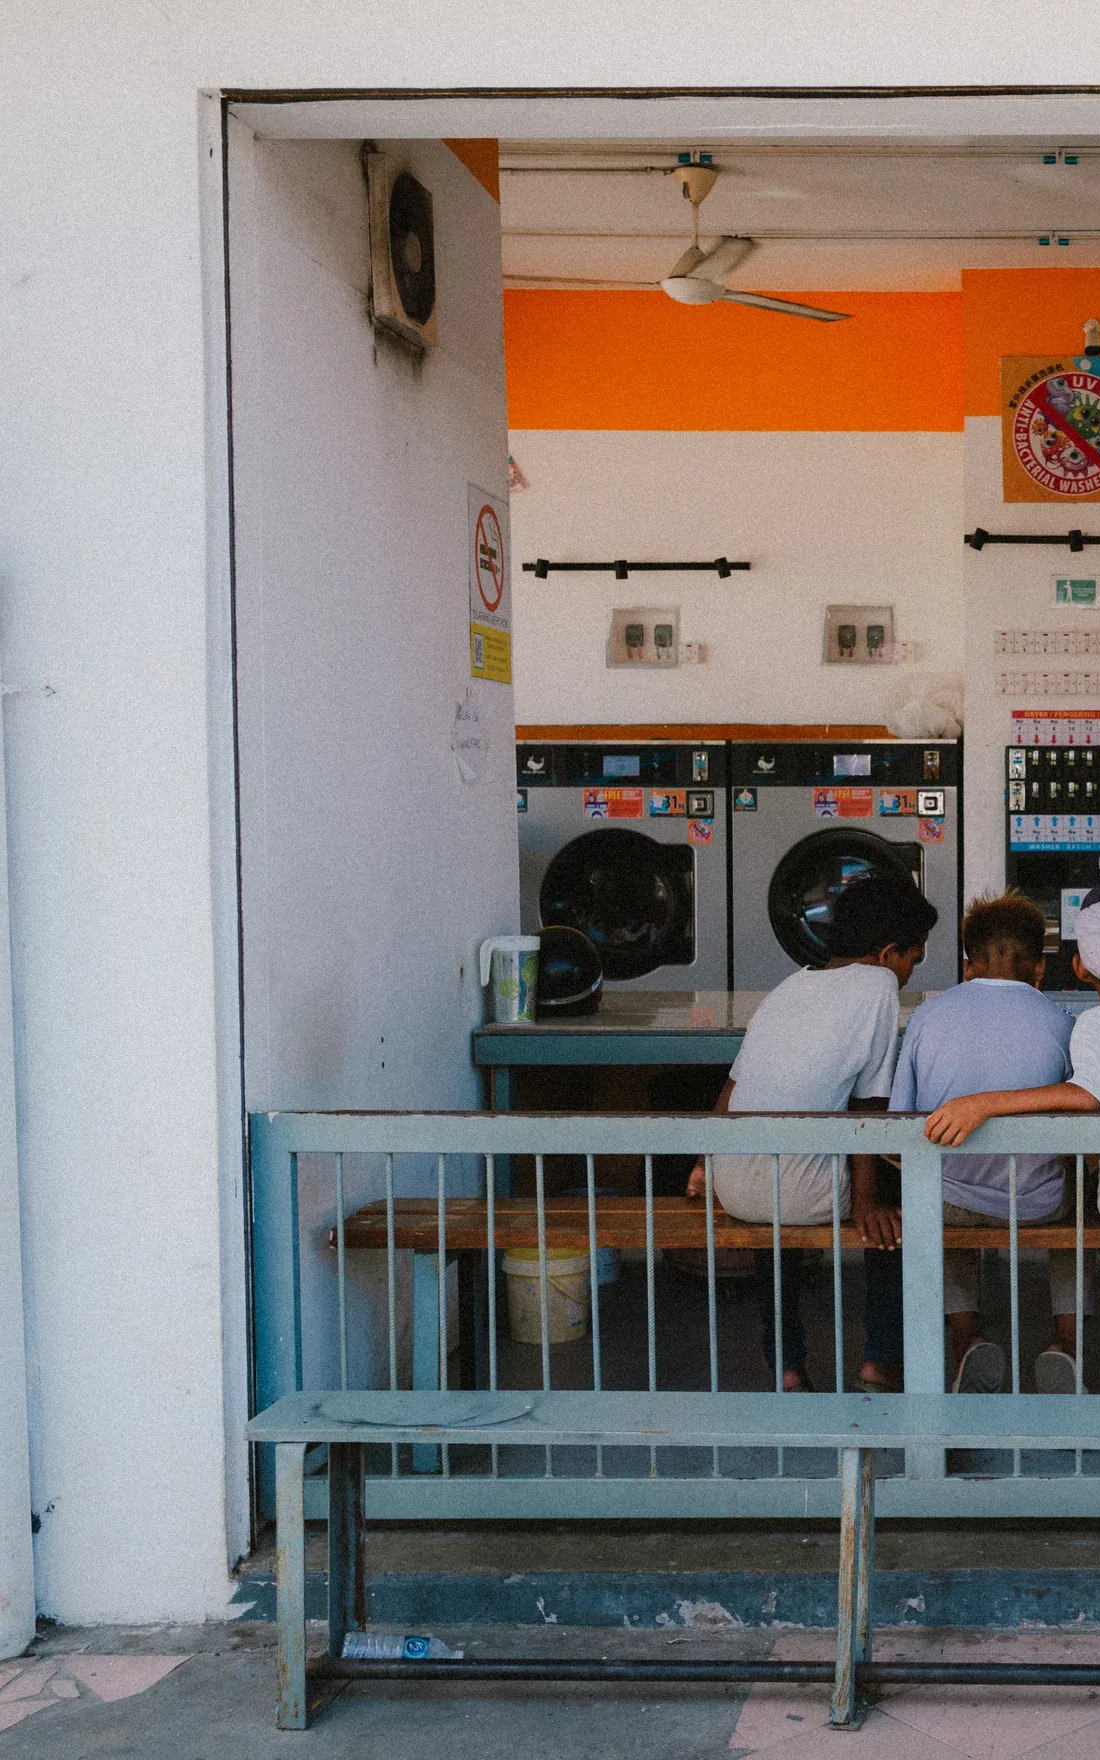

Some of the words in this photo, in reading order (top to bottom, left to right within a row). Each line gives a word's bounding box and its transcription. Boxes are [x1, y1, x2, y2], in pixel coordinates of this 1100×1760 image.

[1072, 375, 1098, 390] UV
[1015, 398, 1056, 490] ANTI-BACTERIAL
[604, 789, 621, 800] FREE
[664, 794, 678, 809] 31
[894, 794, 908, 809] 31
